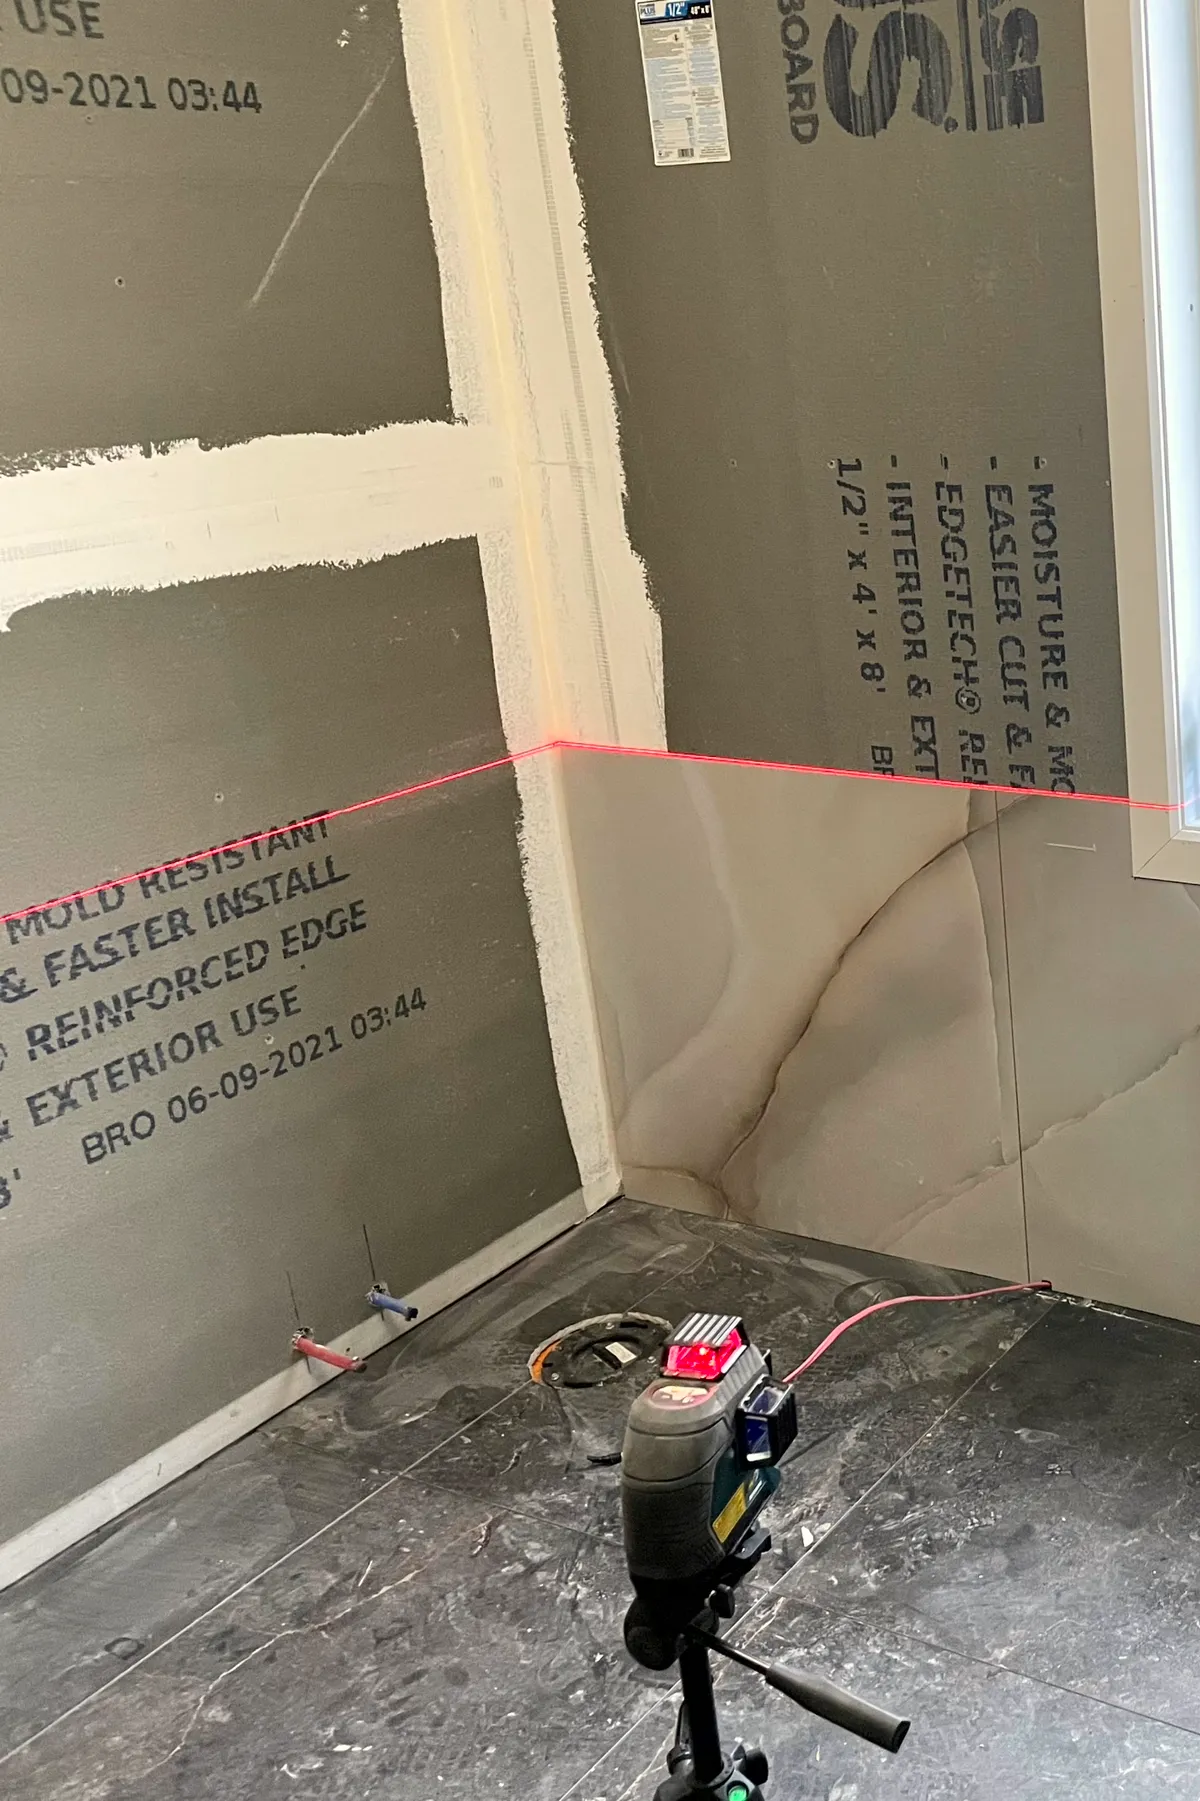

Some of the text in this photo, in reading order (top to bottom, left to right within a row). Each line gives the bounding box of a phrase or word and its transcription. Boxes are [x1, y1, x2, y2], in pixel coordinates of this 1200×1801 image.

[14, 0, 104, 38] USE
[0, 67, 262, 114] 09-2021 03:44
[837, 458, 869, 536] 1/2"
[852, 582, 877, 614] 4'
[886, 482, 928, 661] INTERIOR
[907, 675, 931, 698] &
[985, 484, 1022, 624] EASIER
[1029, 484, 1068, 689] MOISTURE
[860, 662, 885, 693] 8'
[999, 635, 1029, 712] CUT
[1045, 703, 1071, 728] &
[1005, 722, 1032, 754] &
[5, 809, 331, 945] MOLD RESISTANT
[43, 907, 196, 988] FASTER
[204, 855, 351, 929] INSTALL
[25, 900, 368, 1061] REINFORCED EDGE
[25, 985, 303, 1127] EXTERIOR USE
[81, 1110, 155, 1164] BRO
[167, 1025, 343, 1125] 06-09-2021
[350, 986, 427, 1040] 03:44
